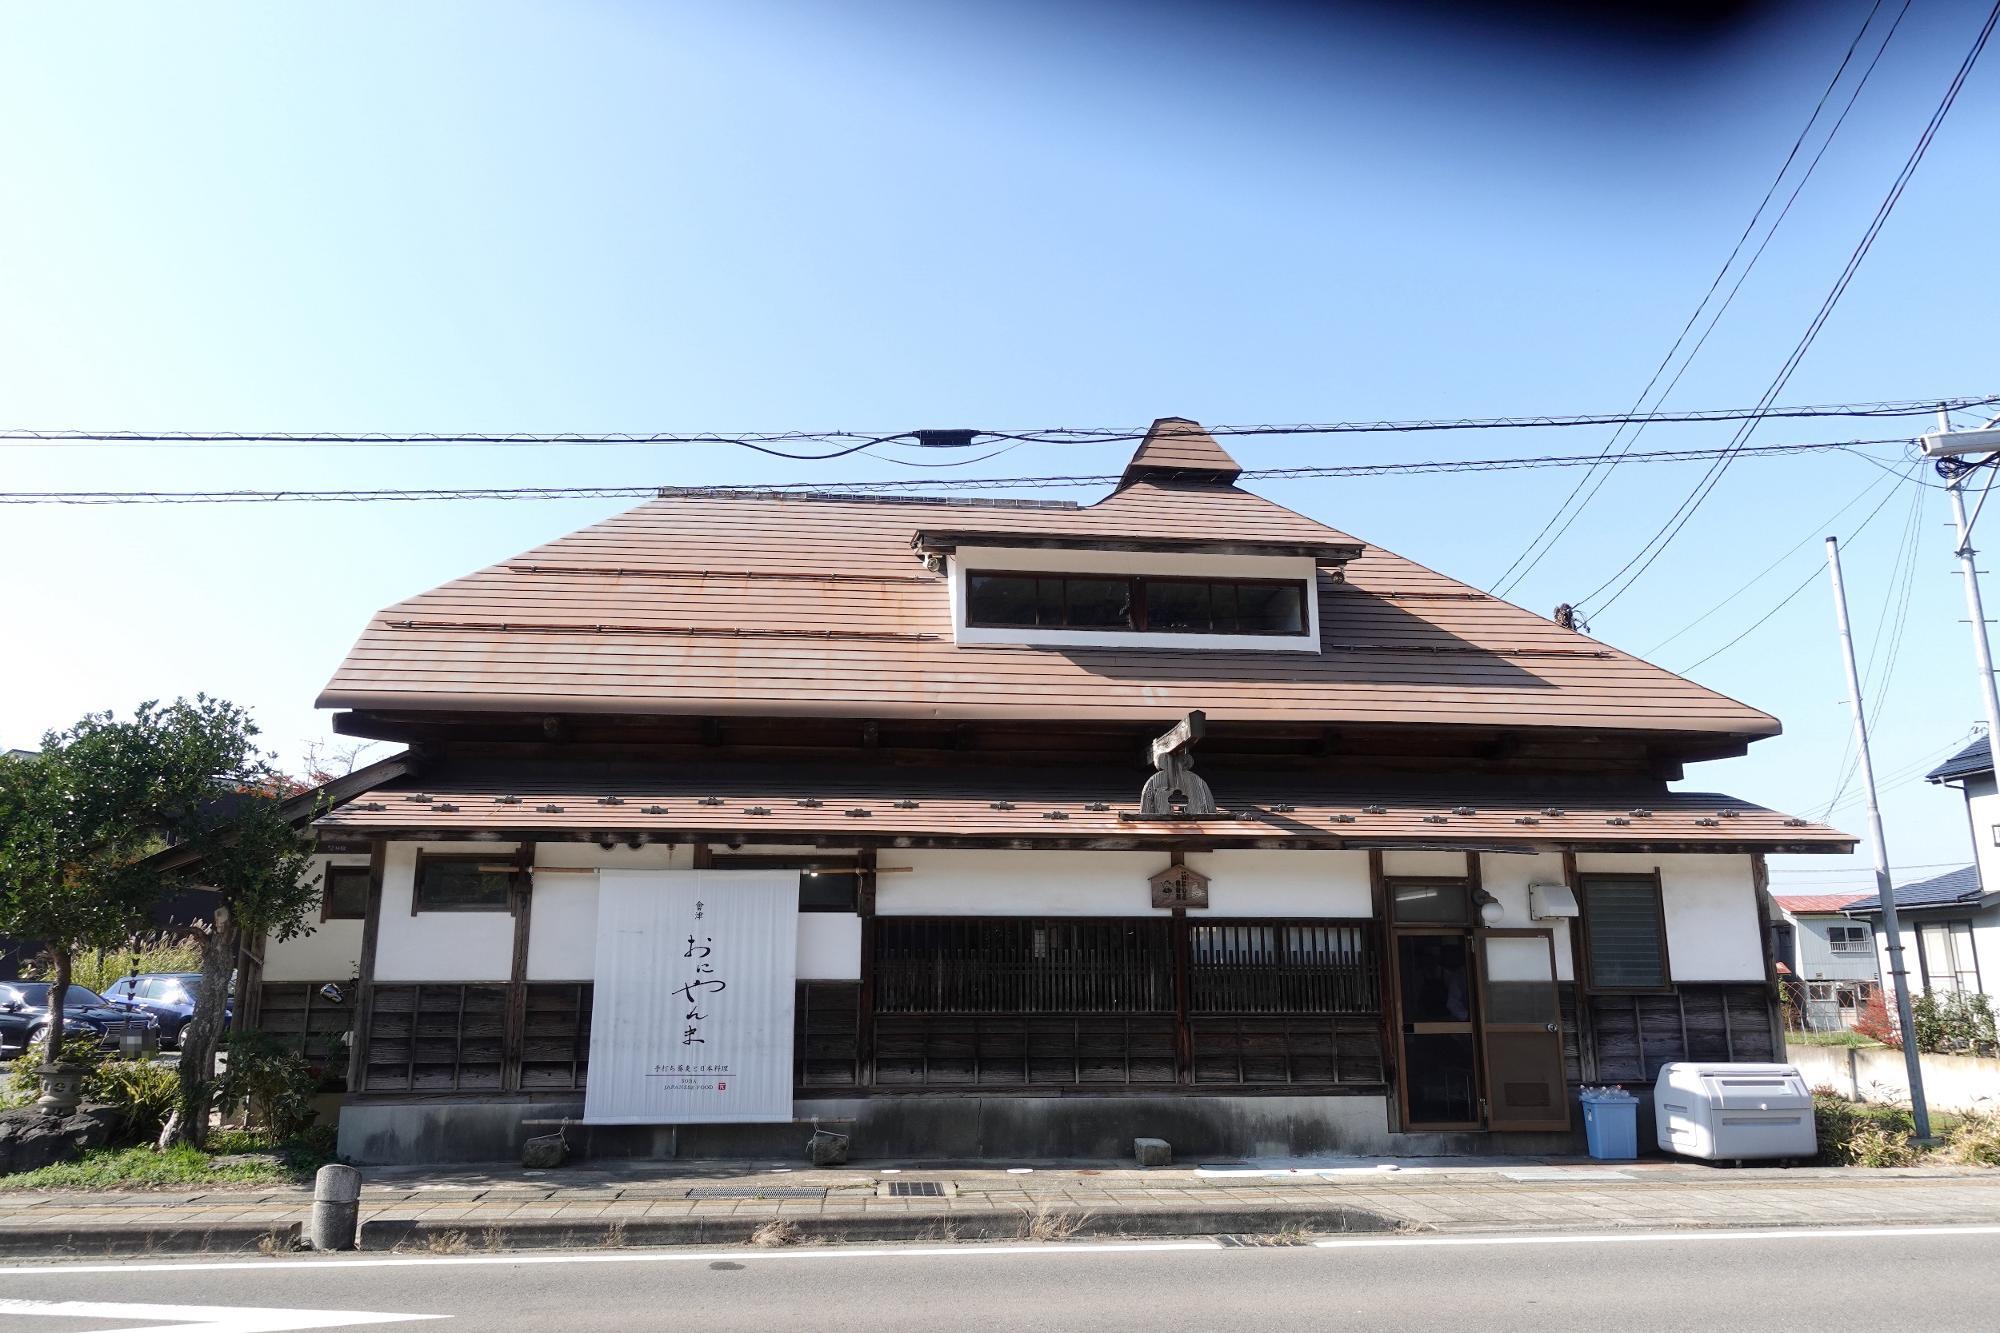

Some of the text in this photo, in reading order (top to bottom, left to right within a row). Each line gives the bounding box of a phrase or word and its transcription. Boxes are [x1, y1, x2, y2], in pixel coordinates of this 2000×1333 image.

[695, 901, 704, 920] 會津
[672, 934, 726, 1045] おにやんま
